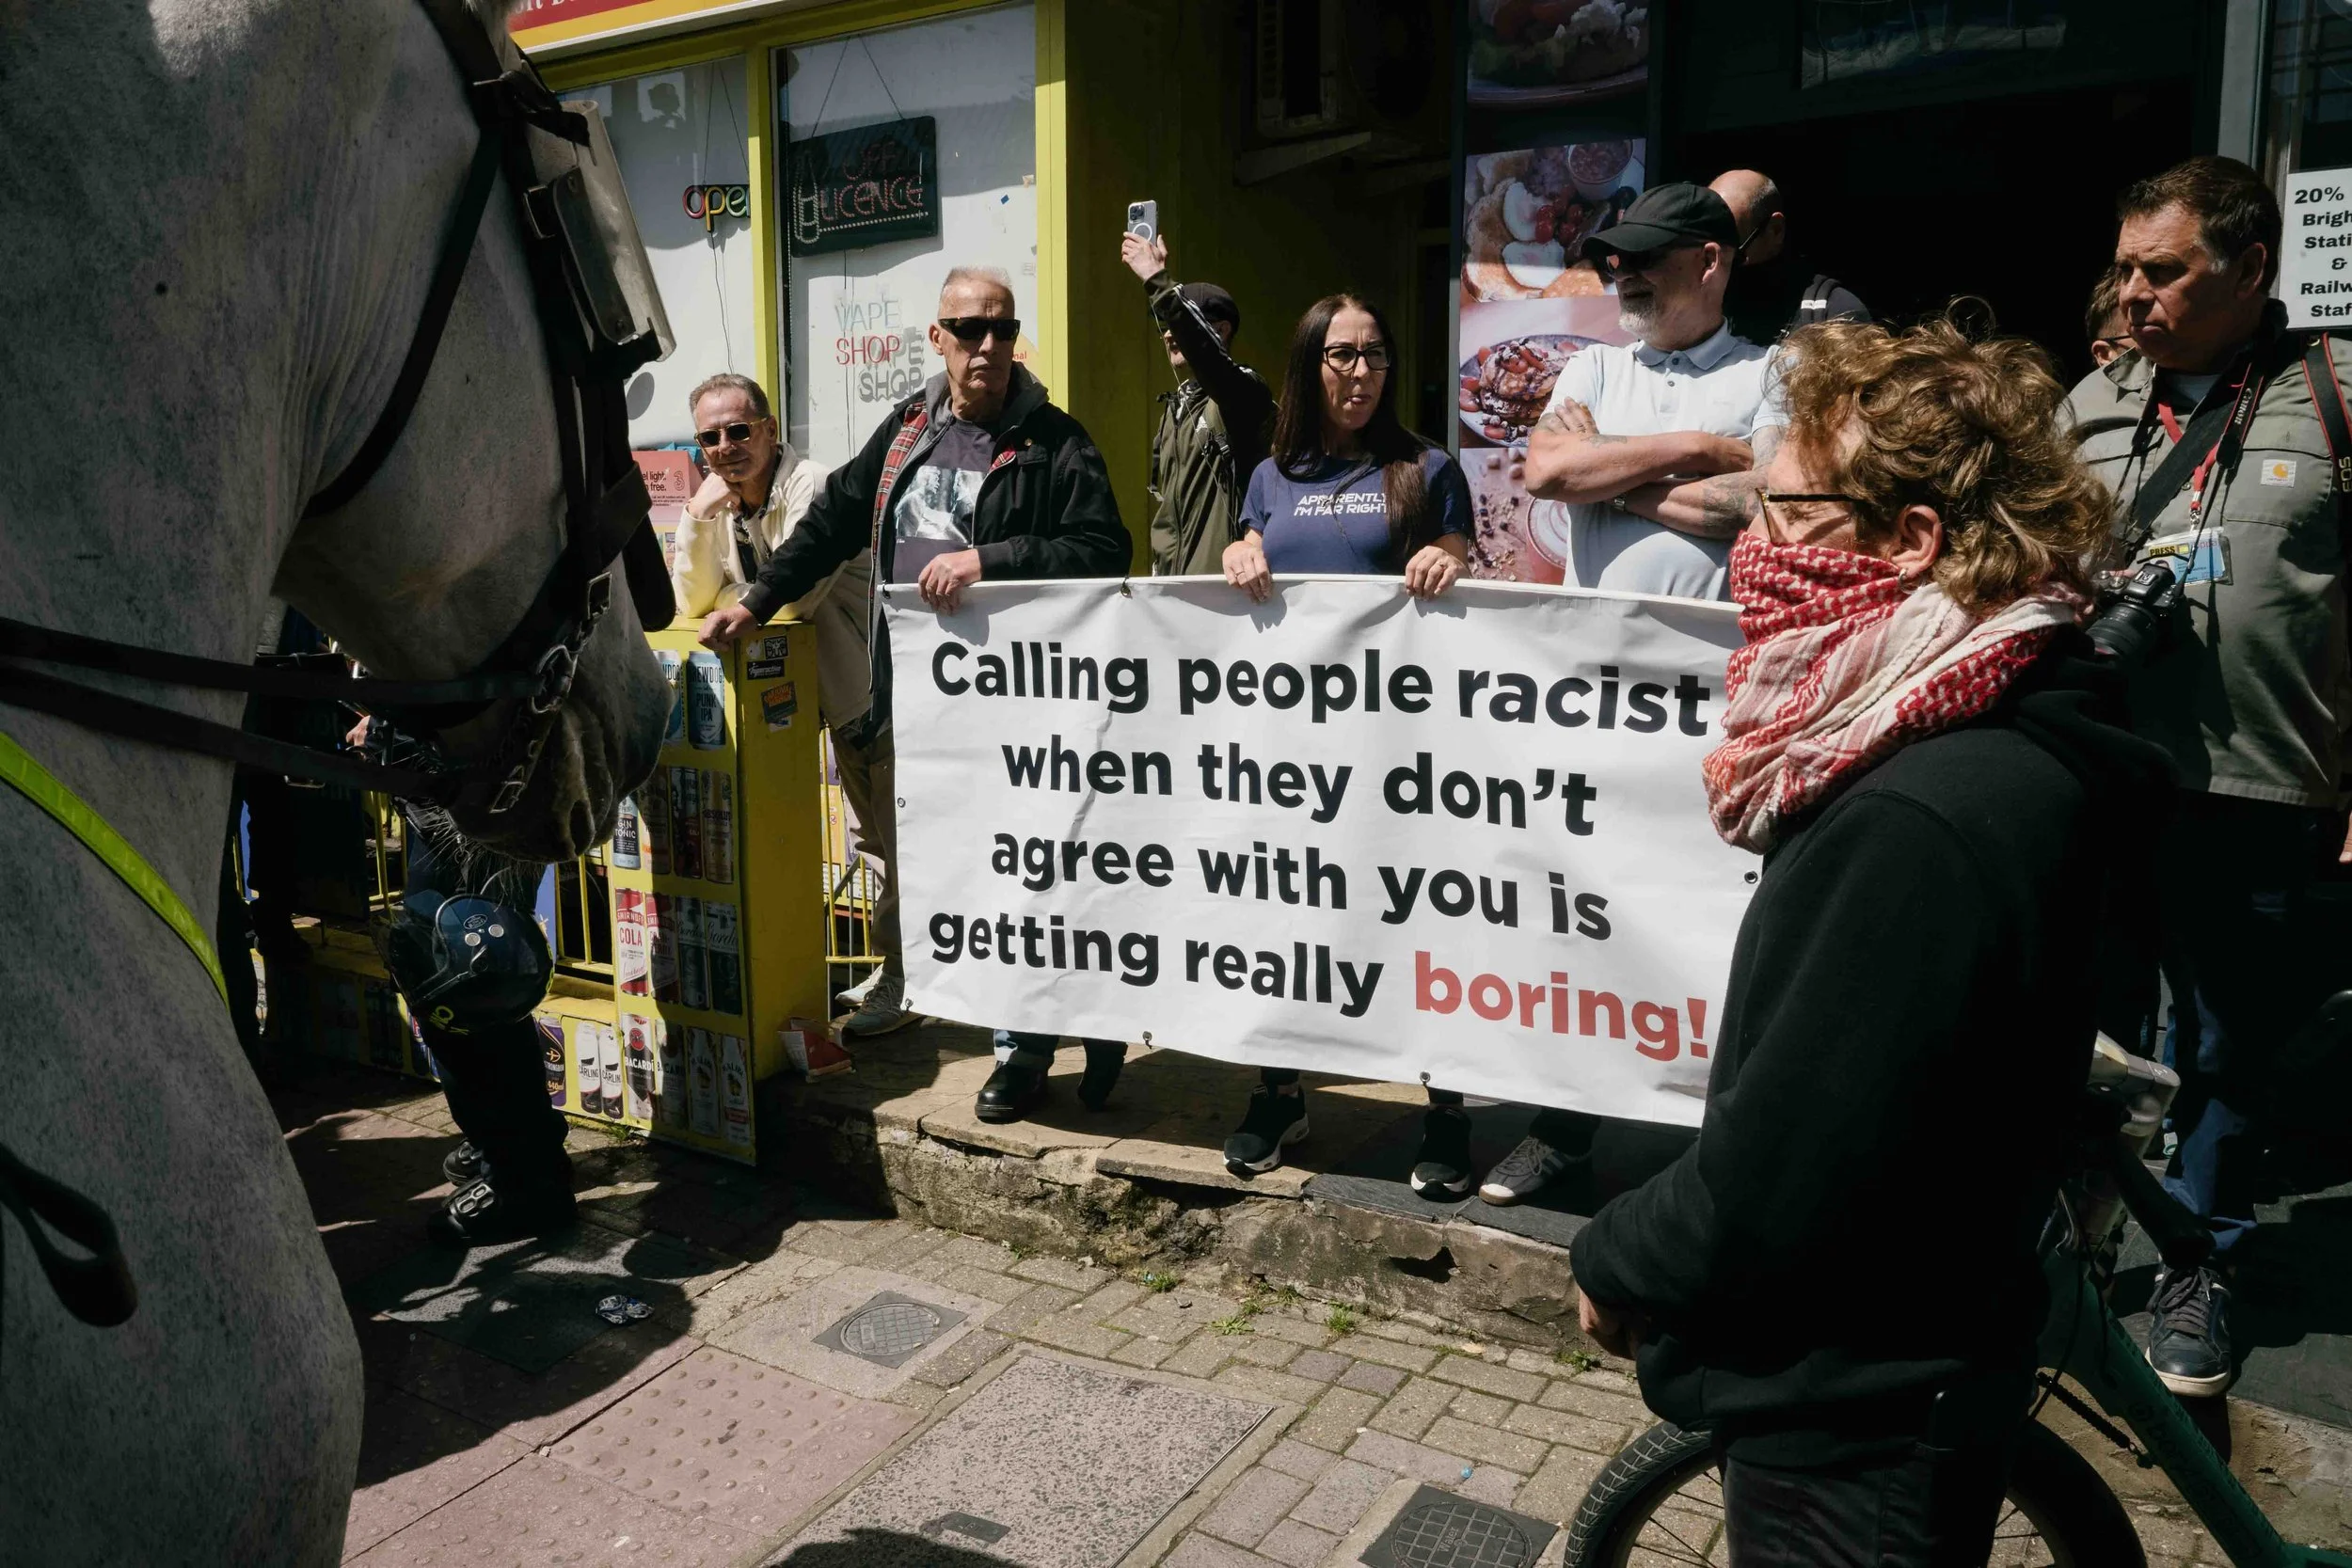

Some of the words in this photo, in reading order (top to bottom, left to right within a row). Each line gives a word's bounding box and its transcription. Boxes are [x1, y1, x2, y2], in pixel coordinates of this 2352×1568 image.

[819, 175, 925, 222] LICENCE
[2295, 186, 2345, 204] 20%
[2304, 233, 2352, 249] Stati
[2331, 257, 2348, 270] &
[834, 299, 900, 331] VAPE
[835, 335, 900, 365] SHOP
[2233, 388, 2253, 425] Canon
[2339, 456, 2352, 492] EOS
[1294, 506, 1312, 516] I'M
[1313, 505, 1339, 515] FAR
[1346, 503, 1388, 514] RIGHT
[2149, 546, 2176, 556] PRESS
[932, 641, 1149, 714] Calling
[1179, 649, 1433, 724] people
[1459, 665, 1711, 736] racist
[695, 692, 717, 707] PUNK
[700, 707, 713, 721] IPA
[1002, 735, 1172, 796] when
[1198, 743, 1353, 824] they
[1384, 752, 1597, 836] don't
[614, 828, 637, 838] TONIC
[617, 820, 632, 829] GIN
[993, 833, 1174, 893] agree
[1198, 842, 1347, 911] with
[1377, 866, 1518, 928] you
[1549, 872, 1612, 941] is
[617, 911, 644, 926] SMIRNOFF
[619, 927, 643, 946] COLA
[930, 912, 1159, 987] getting
[1185, 940, 1385, 1019] really
[1415, 951, 1710, 1063] boring!
[579, 1064, 599, 1078] CARLING
[1438, 1527, 1459, 1553] Water
